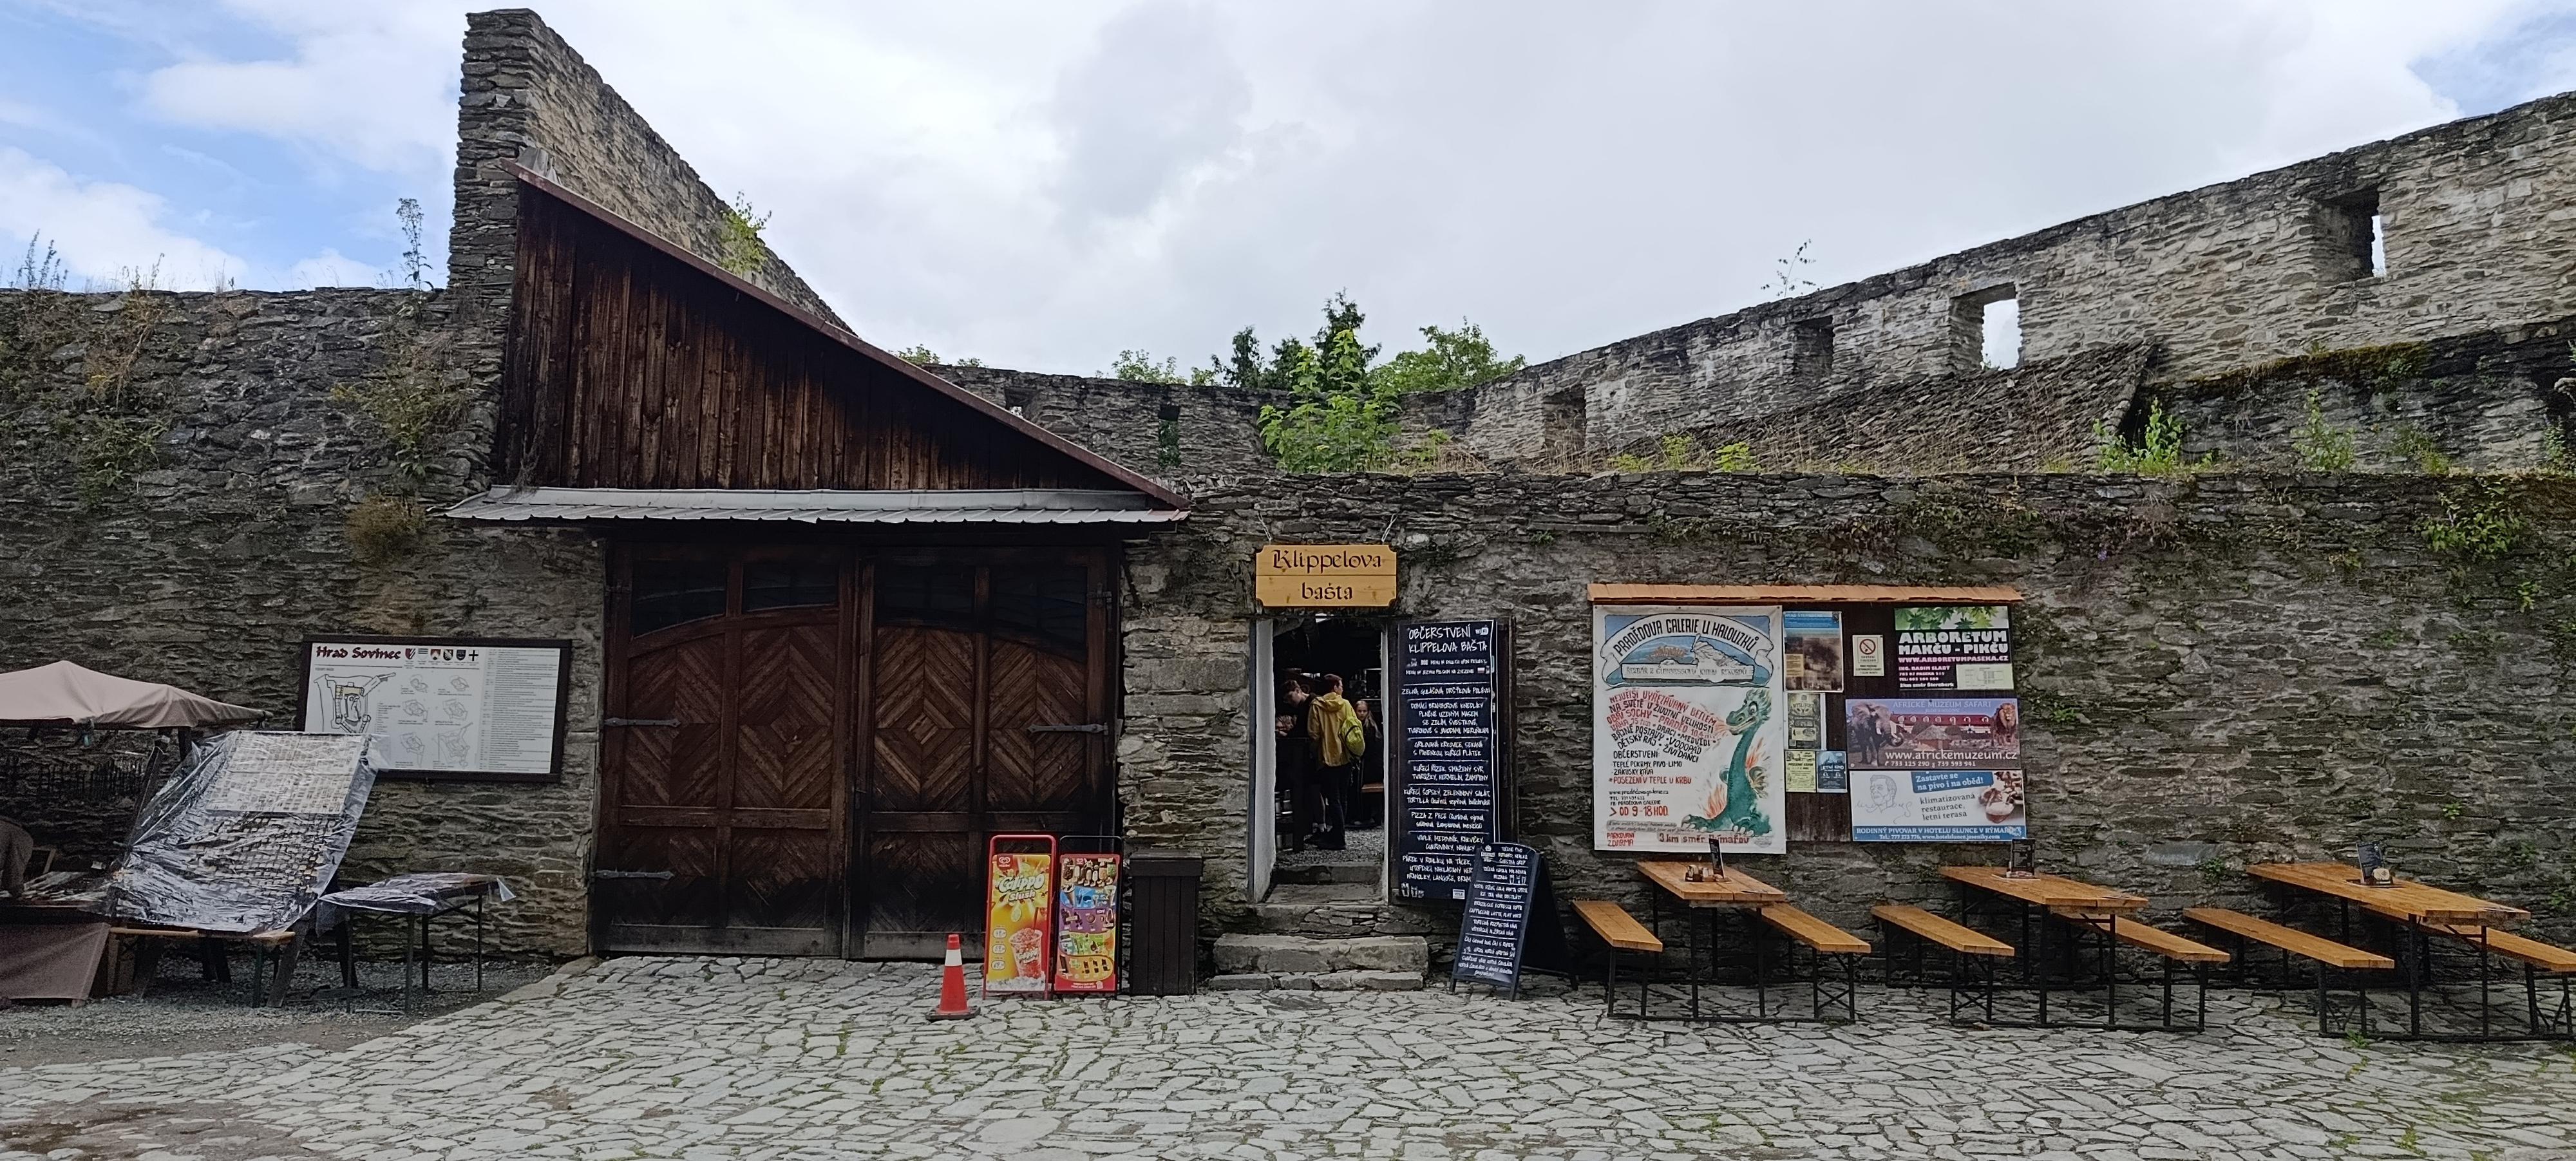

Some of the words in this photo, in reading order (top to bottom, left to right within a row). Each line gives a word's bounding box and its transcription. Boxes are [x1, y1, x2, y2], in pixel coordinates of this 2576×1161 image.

[1272, 550, 1381, 574] Klippelova
[1408, 623, 1470, 639] OBČERSTVENÍ
[1666, 619, 1698, 634] GALERIE
[1702, 619, 1709, 634] U
[1712, 621, 1759, 652] HALOUZKŮ
[1899, 630, 2007, 643] ARBORETUM
[316, 646, 348, 658] Hrad
[352, 647, 401, 659] Sovinec
[1408, 641, 1457, 653] KLIPPELOVA
[1461, 639, 1487, 651] BAŠTA
[1899, 643, 1951, 655] MAKČU
[1964, 642, 2008, 654] PIKČU
[1609, 703, 1621, 713] NA
[1681, 713, 1714, 733] VELIKOSTI
[1627, 709, 1653, 719] SOCHY
[1656, 724, 1676, 737] DRACI
[1635, 725, 1665, 741] POSTAVY
[1669, 738, 1702, 755] VODOPÁD
[1886, 749, 2017, 760] www.africkemuzeum.cz
[1915, 773, 1949, 783] Zastavte
[1928, 782, 1945, 791] pivo
[1962, 777, 1984, 786] oběd!
[1919, 793, 1975, 805] klimatizovaná
[1620, 807, 1629, 816] OD
[1654, 807, 1668, 816] HOD
[1921, 804, 1964, 813] restaurace,
[1985, 827, 2022, 836] RÝMAŘ
[1683, 835, 1704, 844] směr
[1709, 834, 1749, 844] mařov
